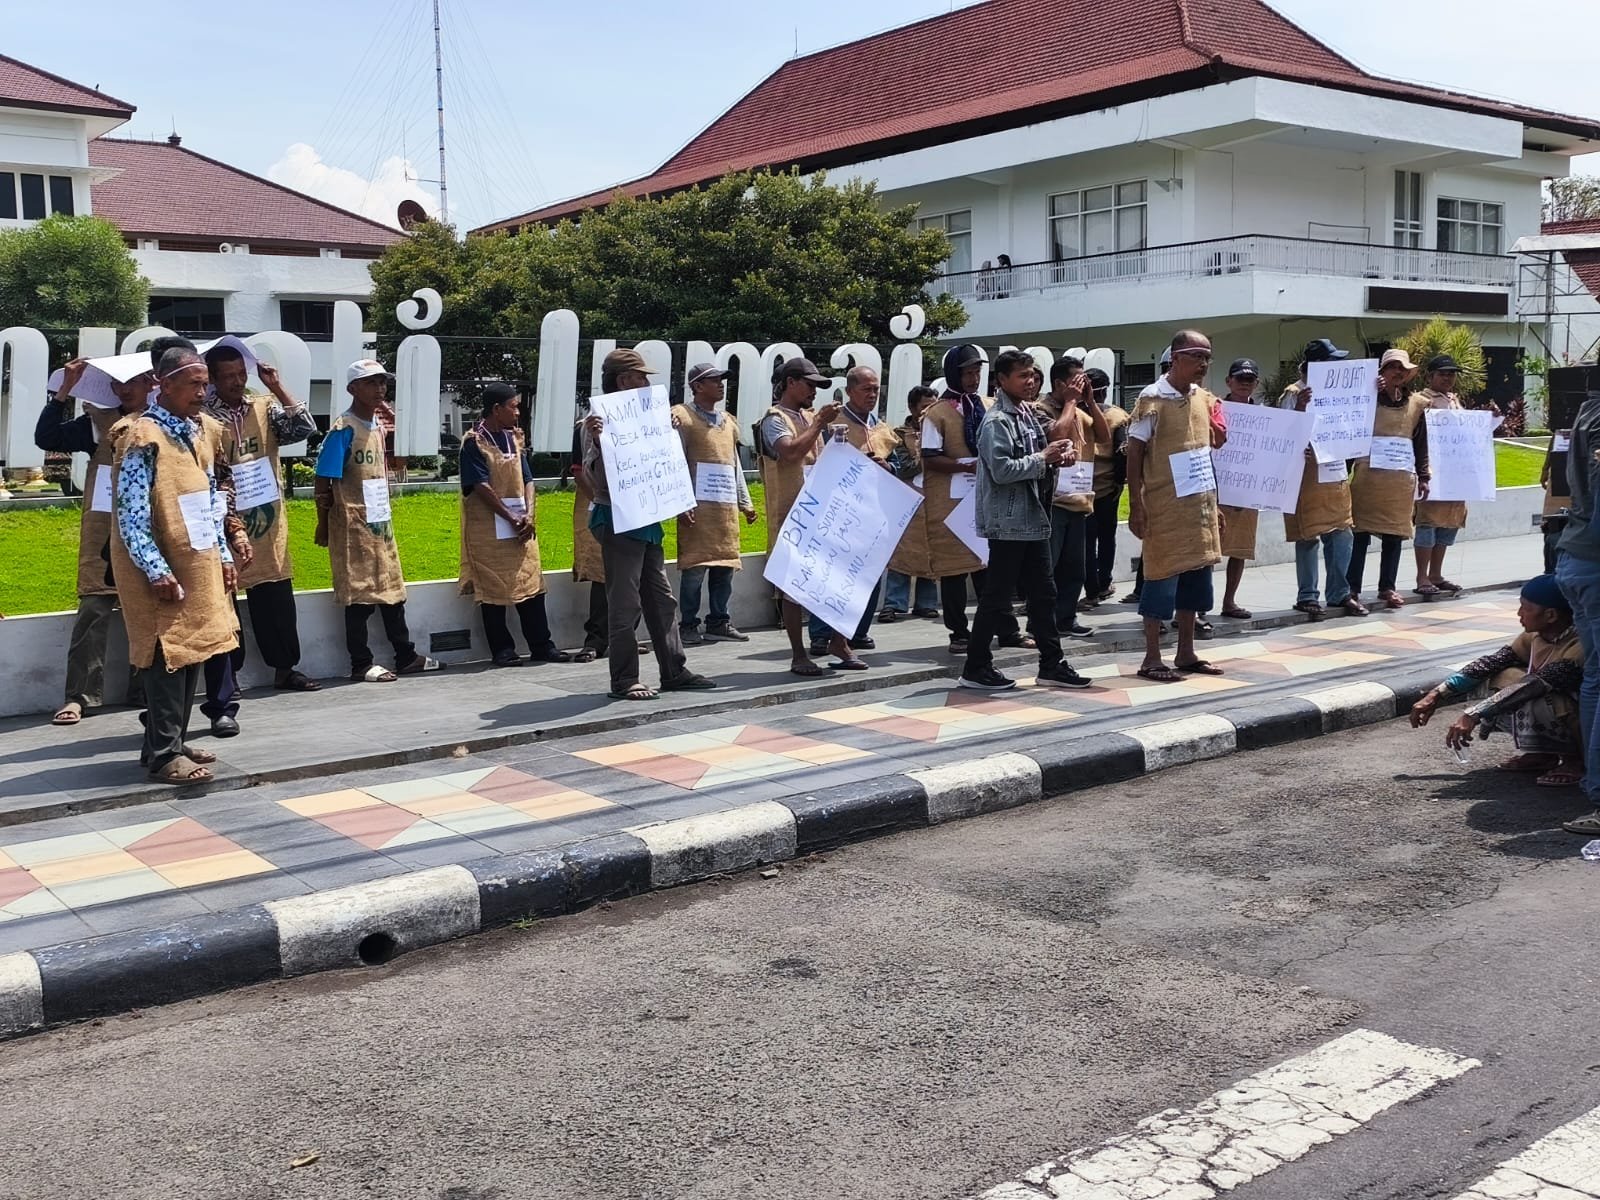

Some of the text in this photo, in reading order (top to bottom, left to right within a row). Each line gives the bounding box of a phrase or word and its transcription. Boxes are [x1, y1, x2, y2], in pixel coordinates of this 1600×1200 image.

[782, 489, 820, 547] BPN
[791, 459, 868, 593] RAKYAT SUDAH MUAK
